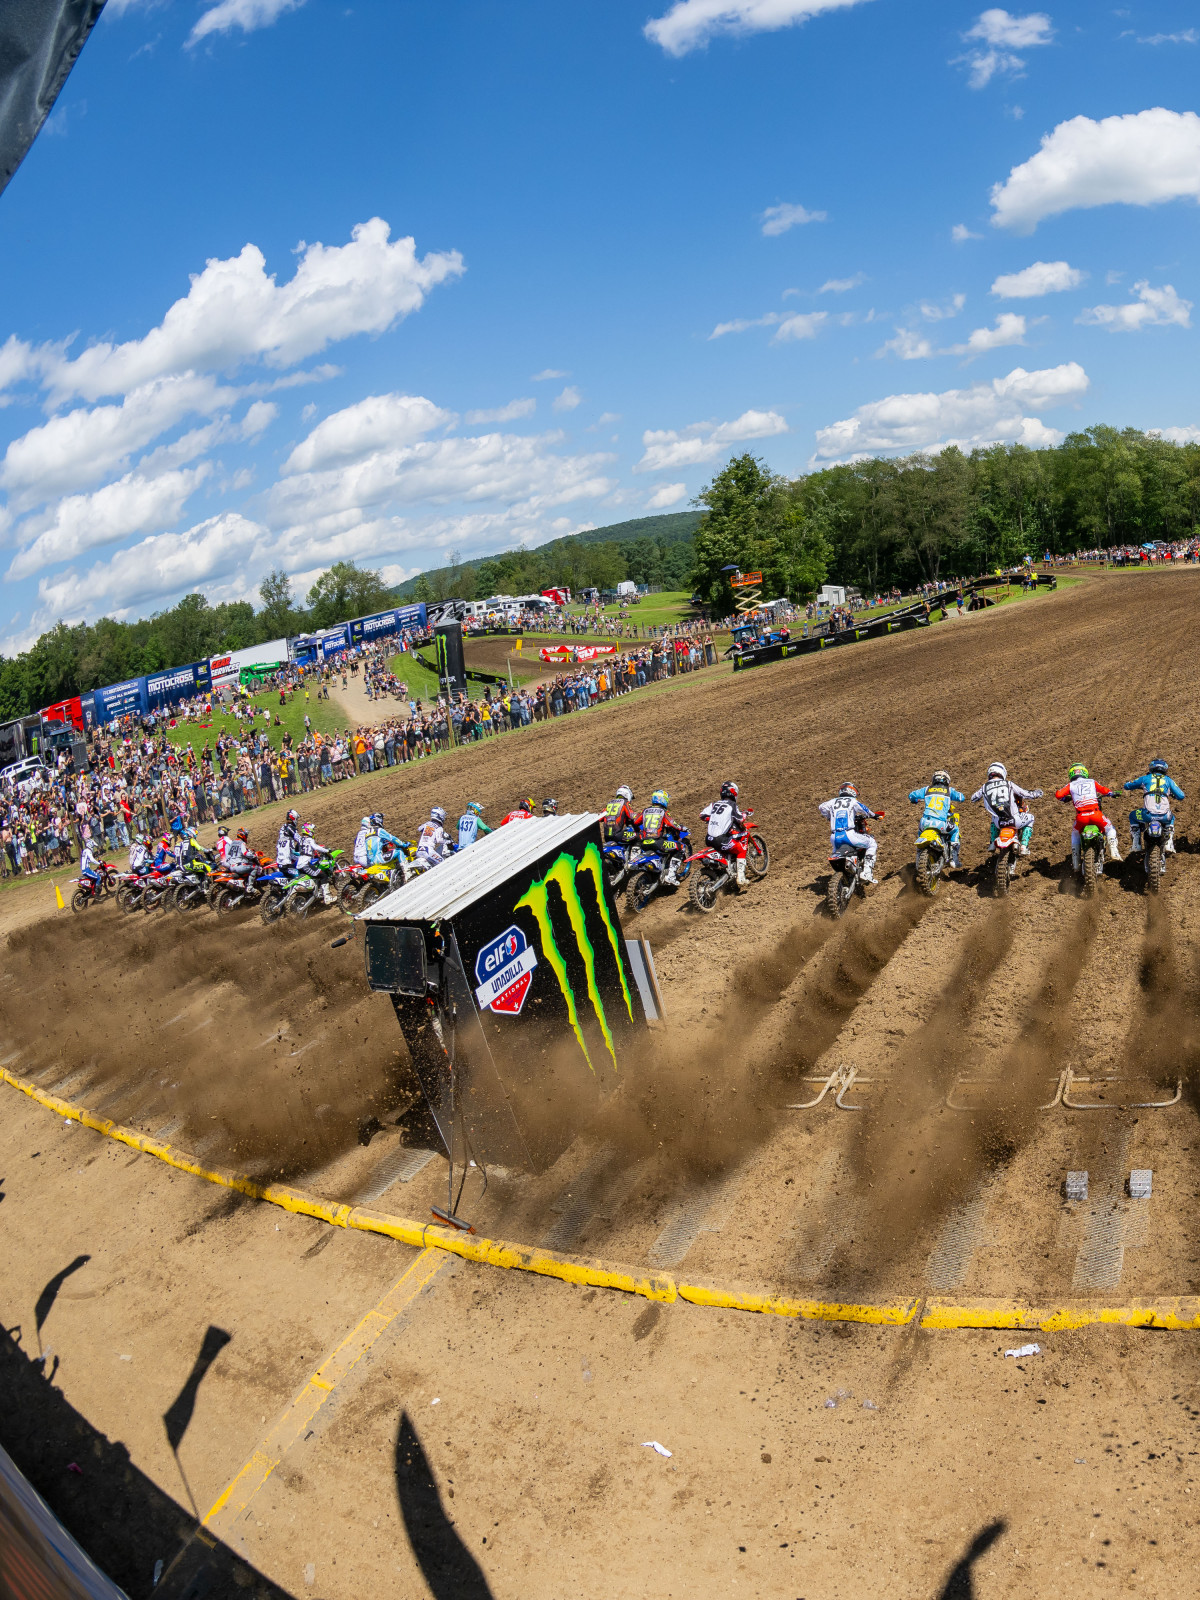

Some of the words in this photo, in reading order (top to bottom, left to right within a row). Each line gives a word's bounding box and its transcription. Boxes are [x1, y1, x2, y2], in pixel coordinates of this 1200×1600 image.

[210, 656, 231, 670] GEAR
[211, 662, 240, 677] SERVICES
[148, 672, 194, 692] MOTOCROSS
[986, 786, 1010, 806] 79
[1078, 784, 1090, 796] 12
[606, 803, 621, 816] 93
[711, 804, 728, 814] 56
[834, 798, 852, 810] 53
[928, 796, 944, 810] 45
[460, 820, 474, 832] 437
[645, 814, 660, 828] 75
[485, 942, 506, 972] elf
[491, 960, 524, 994] UNADILLA
[496, 978, 528, 1006] NATIONAL
